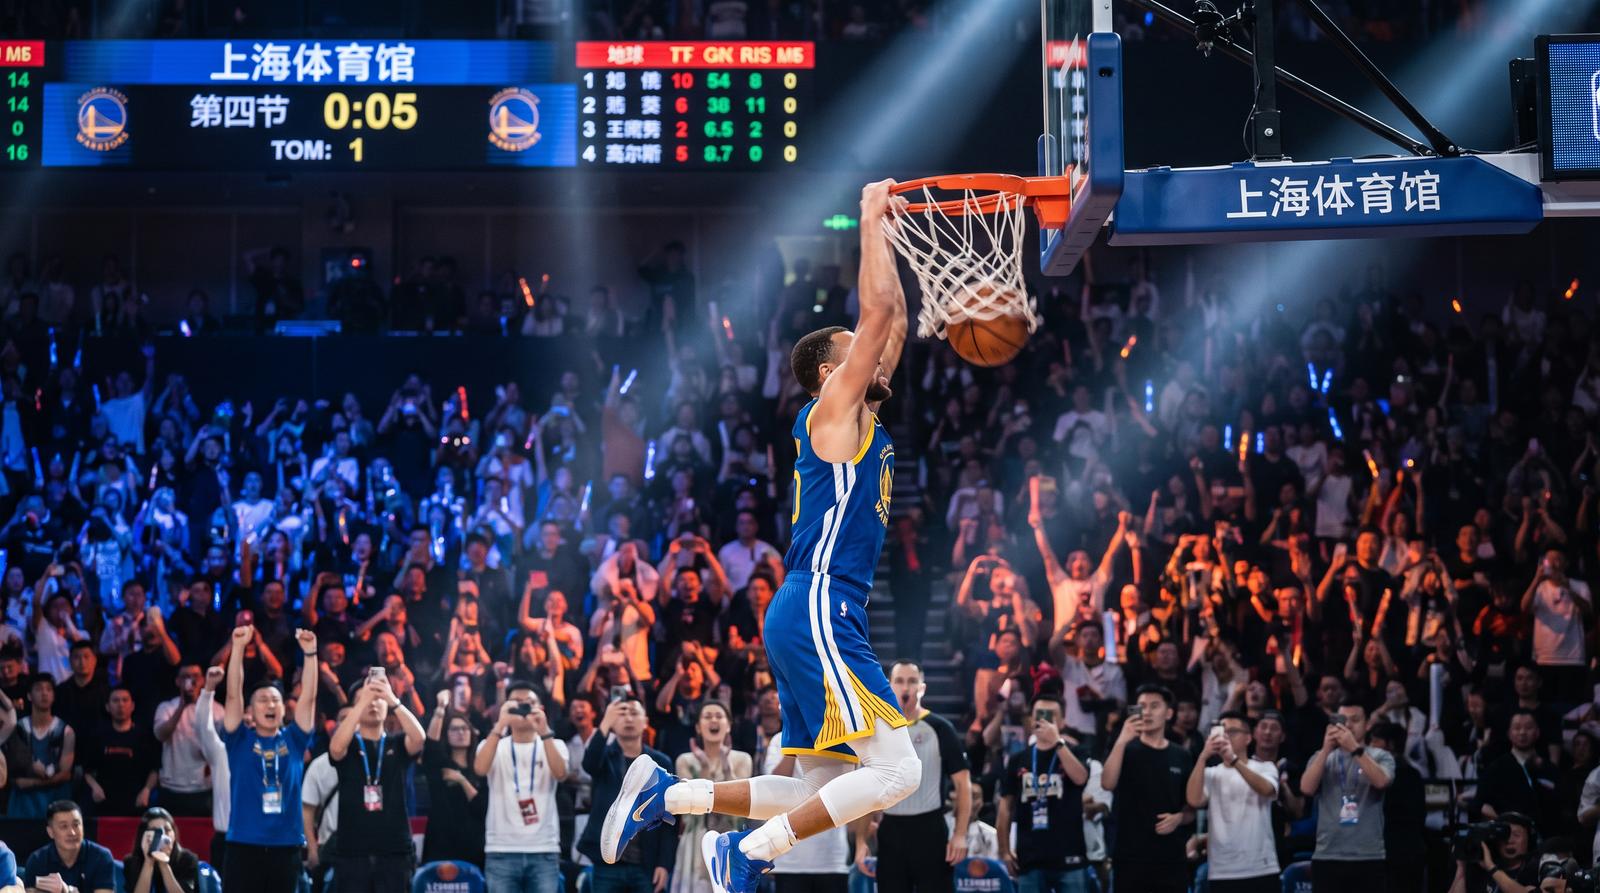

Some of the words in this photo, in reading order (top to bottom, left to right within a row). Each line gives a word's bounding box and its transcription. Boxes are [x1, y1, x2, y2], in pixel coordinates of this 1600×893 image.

[210, 42, 415, 82] 上海体育馆
[8, 72, 30, 88] 14
[583, 72, 594, 89] 1
[671, 72, 694, 89] 10
[706, 72, 731, 89] 54
[783, 73, 797, 89] 0
[7, 96, 30, 112] 14
[190, 93, 290, 128] 第四节
[323, 92, 418, 130] 0:05
[583, 97, 596, 114] 2
[675, 97, 688, 114] 6
[707, 97, 731, 114] 38
[745, 97, 766, 114] 11
[783, 97, 797, 114] 0
[12, 120, 24, 136] 0
[583, 121, 596, 138] 3
[675, 121, 688, 138] 2
[704, 121, 734, 138] 6.5
[749, 121, 762, 138] 2
[783, 121, 797, 138] 0
[7, 144, 28, 160] 16
[270, 140, 332, 160] TOM:
[349, 137, 364, 162] 1
[582, 145, 596, 163] 4
[704, 145, 733, 162] 8.7
[749, 145, 762, 162] 0
[783, 145, 797, 162] 0
[1226, 169, 1440, 219] 上海体育馆
